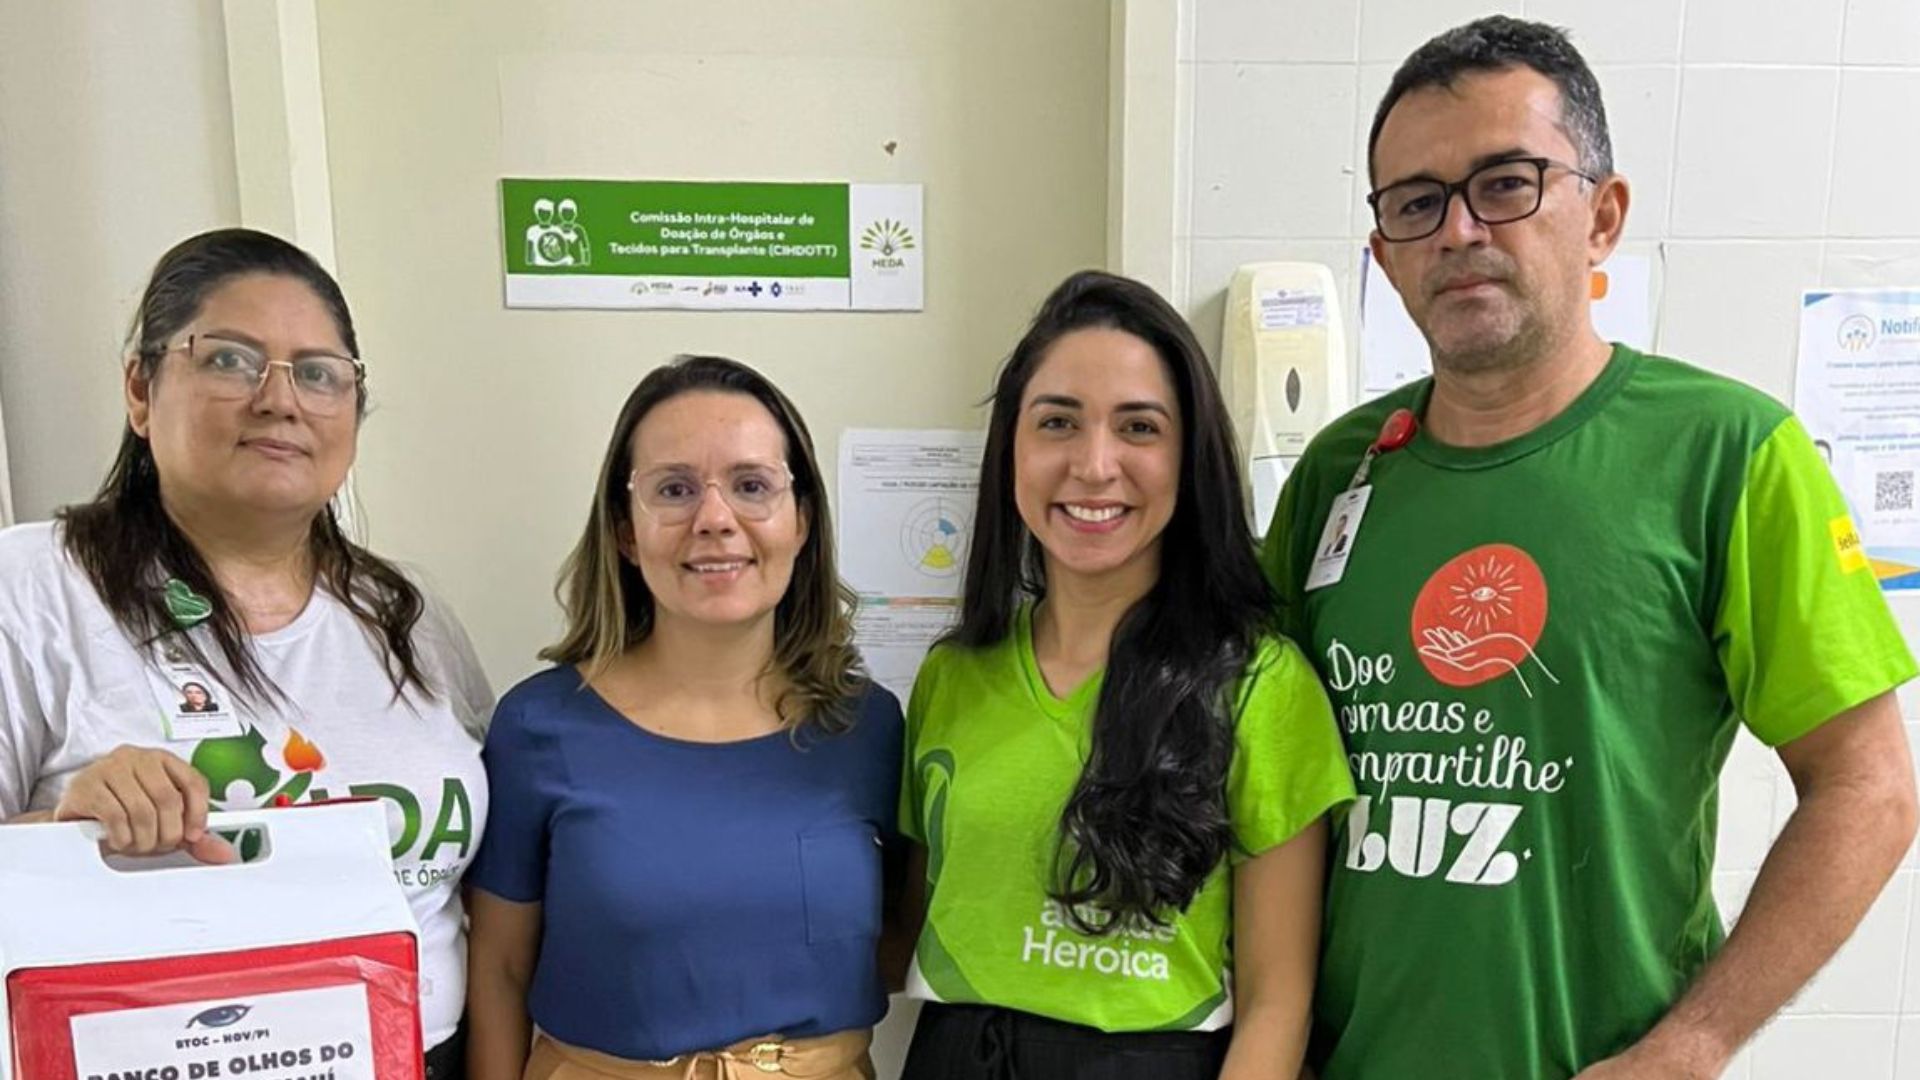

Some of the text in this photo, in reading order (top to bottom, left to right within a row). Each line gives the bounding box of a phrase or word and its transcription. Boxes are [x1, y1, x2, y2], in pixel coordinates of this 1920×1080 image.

[630, 210, 815, 226] Comissão Intra-Hospitalar de
[608, 241, 838, 258] Tecidos para Transplante (CIHDOTT)
[660, 226, 785, 243] Doação de Órgãos e
[1327, 639, 1396, 692] Doe
[1474, 708, 1495, 734] e
[1346, 795, 1523, 885] LUZ
[1021, 926, 1170, 980] Heroica
[188, 1060, 221, 1080] DE
[228, 1048, 313, 1076] OLHOS
[319, 1042, 355, 1063] DO
